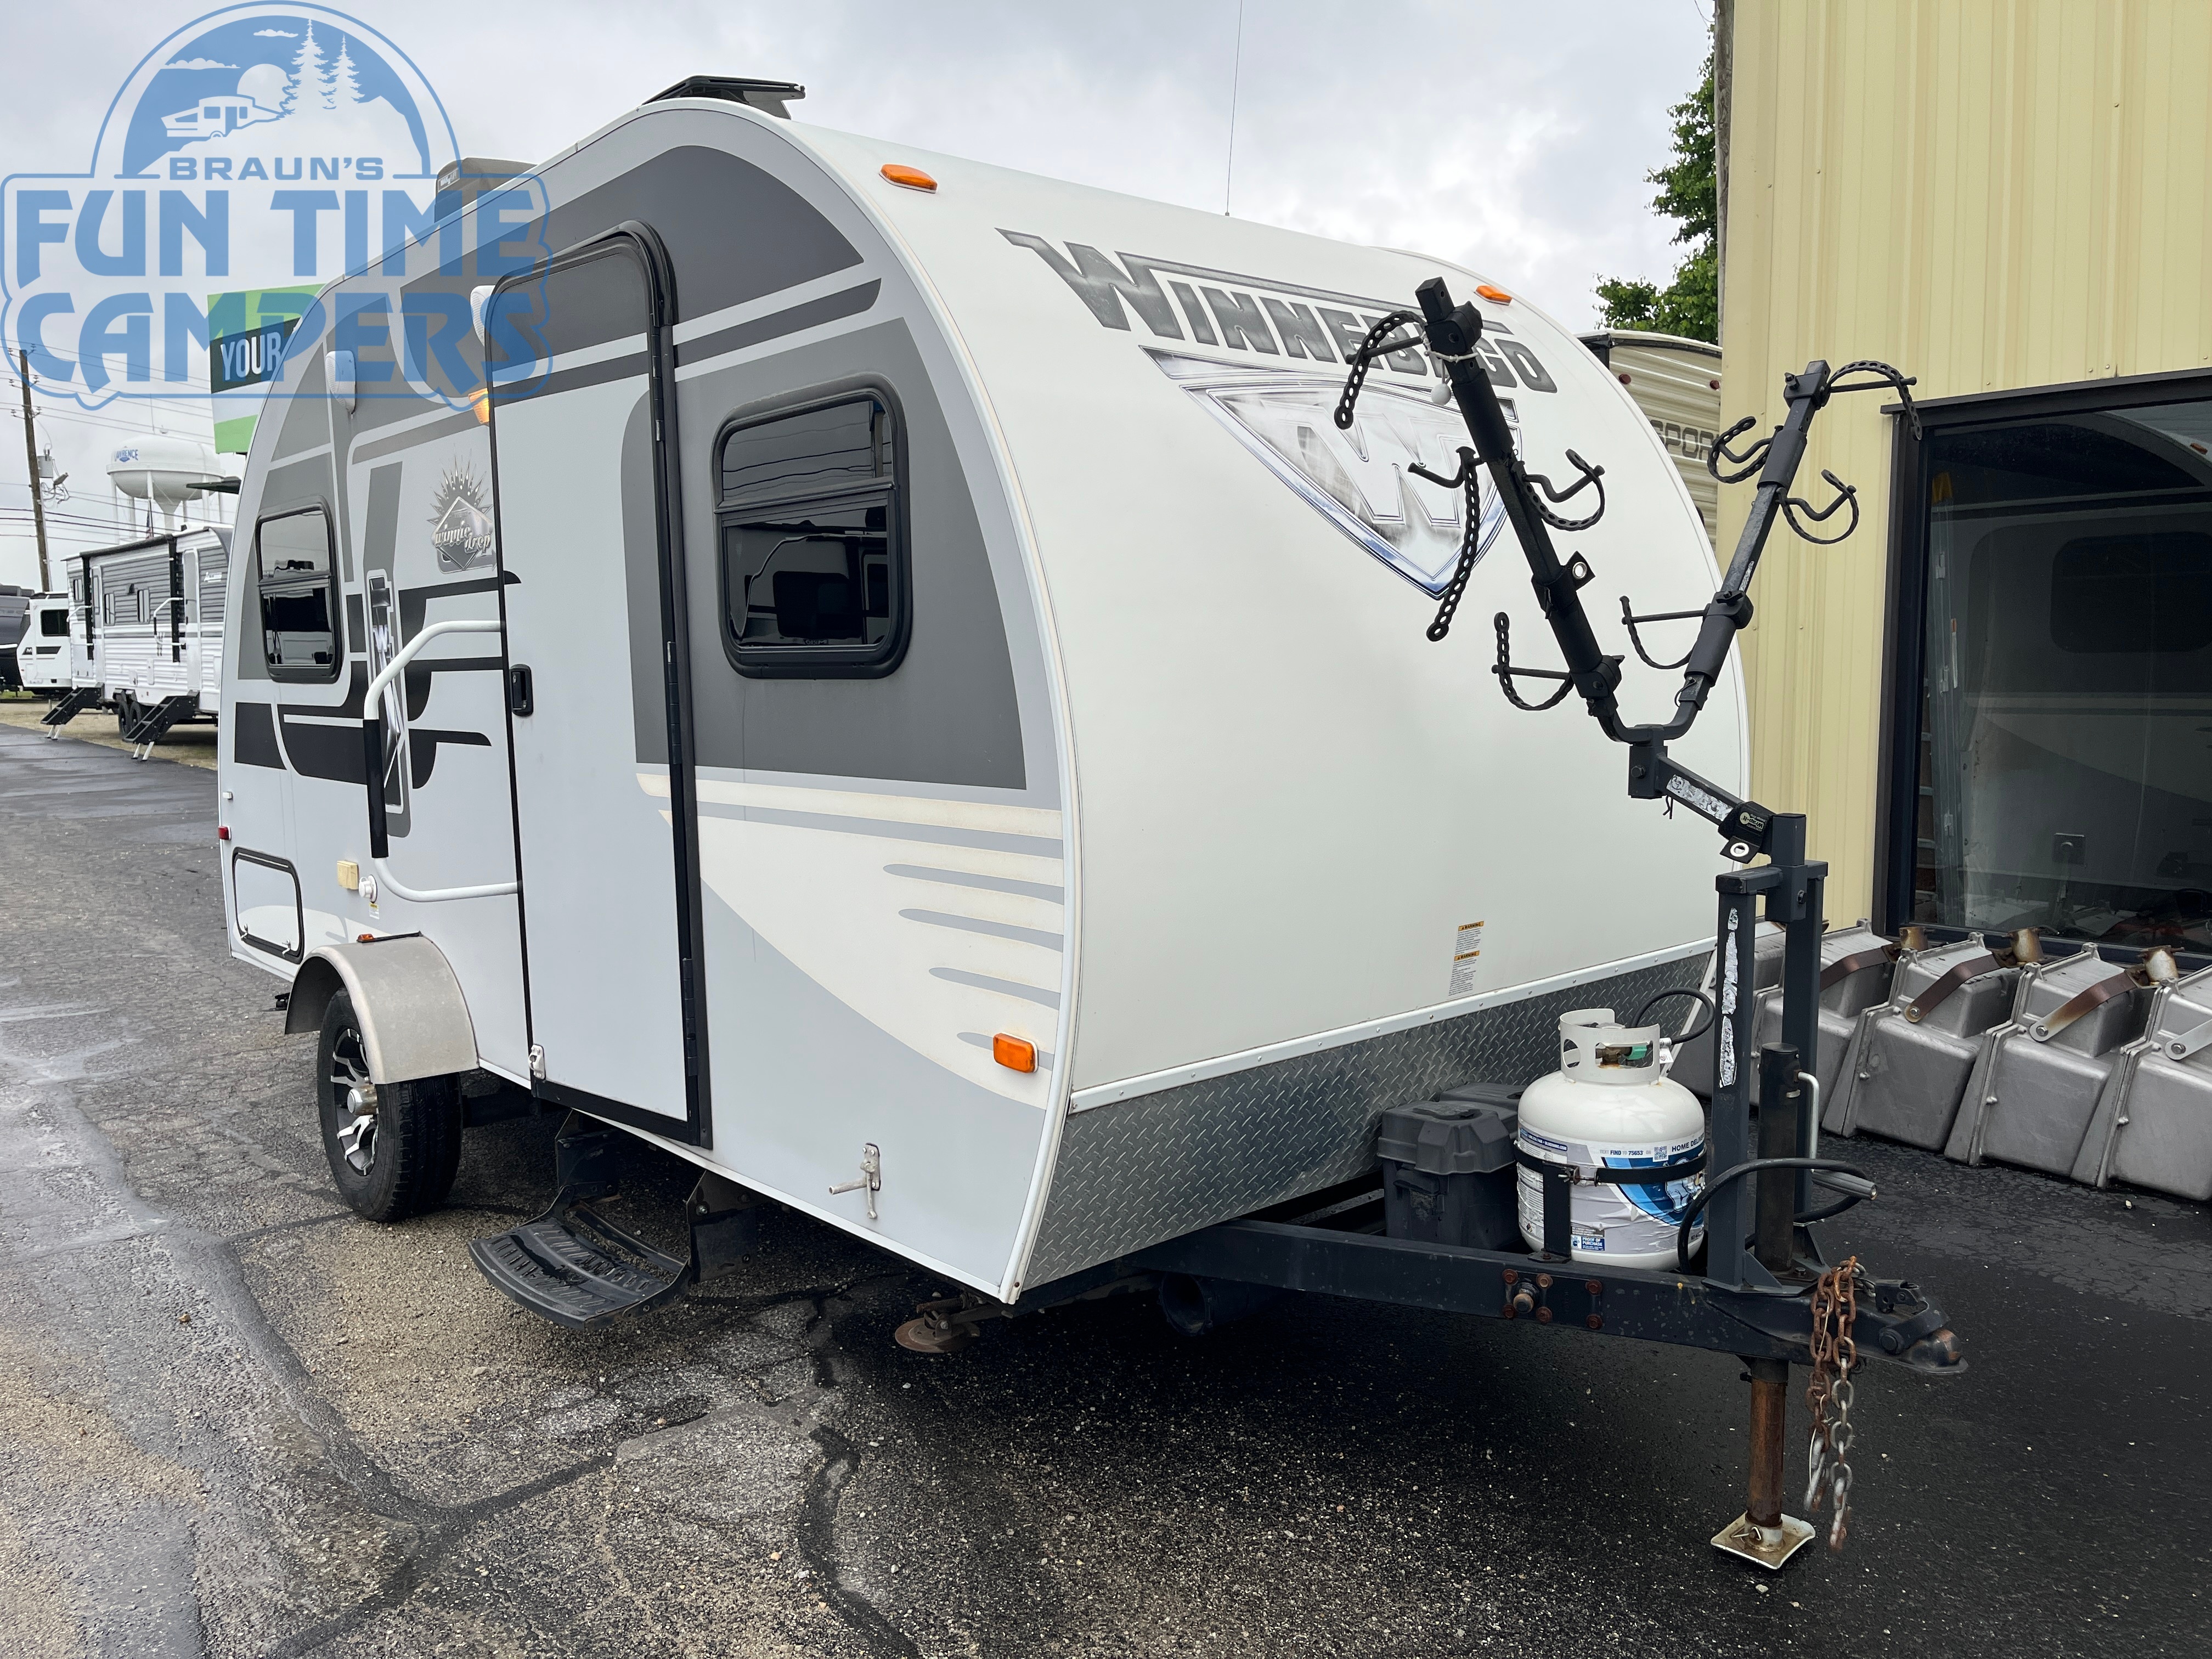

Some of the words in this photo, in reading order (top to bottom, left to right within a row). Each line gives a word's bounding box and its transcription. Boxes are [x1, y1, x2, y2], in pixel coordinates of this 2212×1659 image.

[995, 228, 1558, 394] WINNEBGO
[220, 331, 282, 381] YOUR
[465, 532, 491, 554] drop
[1672, 1142, 1690, 1152] HOME
